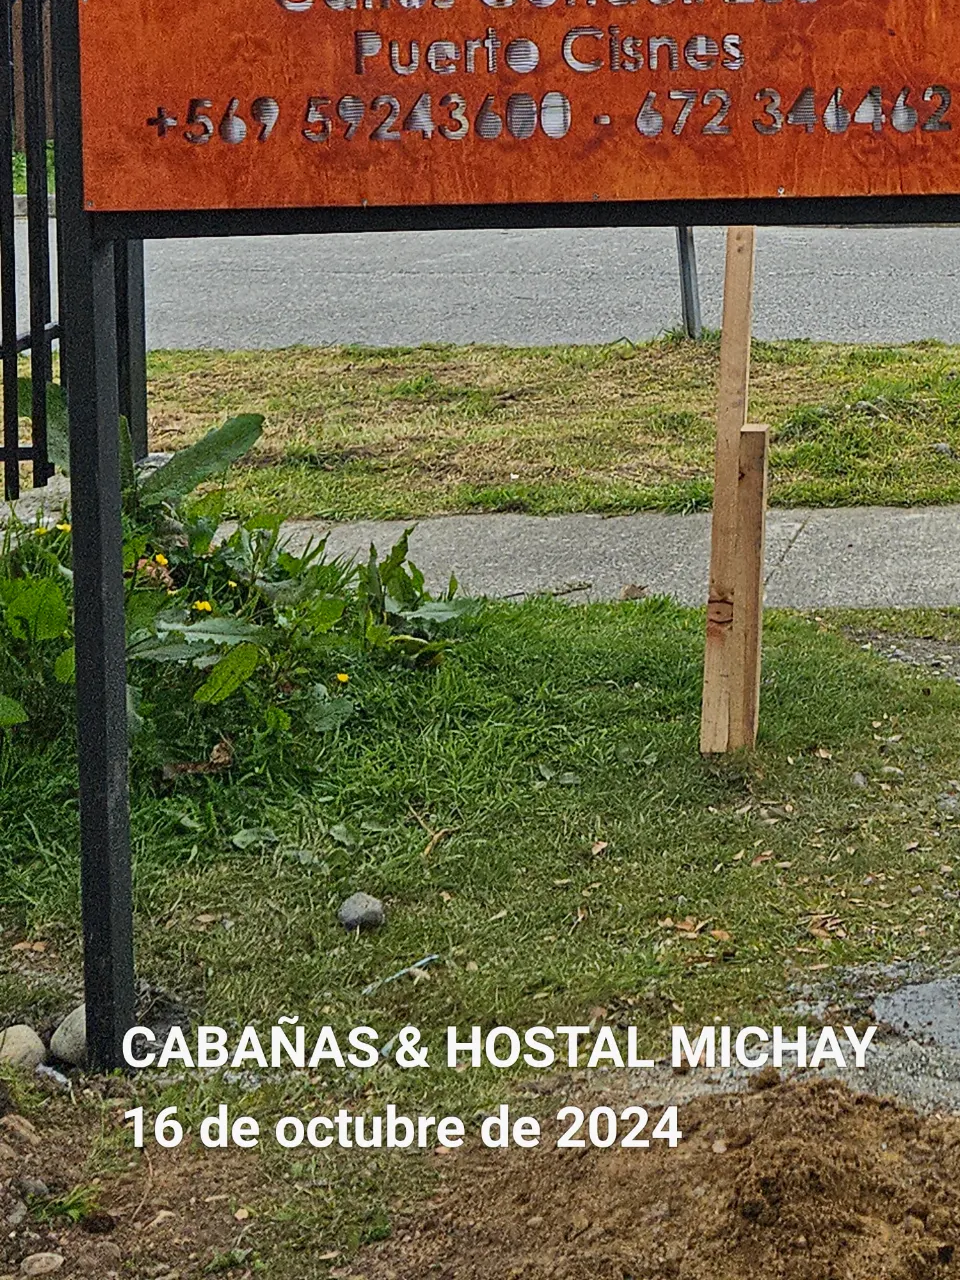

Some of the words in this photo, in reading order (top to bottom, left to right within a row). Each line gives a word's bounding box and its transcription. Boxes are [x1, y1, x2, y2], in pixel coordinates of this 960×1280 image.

[354, 27, 541, 76] Puerto
[559, 25, 747, 74] Cisnes
[146, 96, 280, 145] +569
[302, 91, 573, 143] 59243600
[635, 88, 733, 137] 672
[751, 84, 953, 135] 346462
